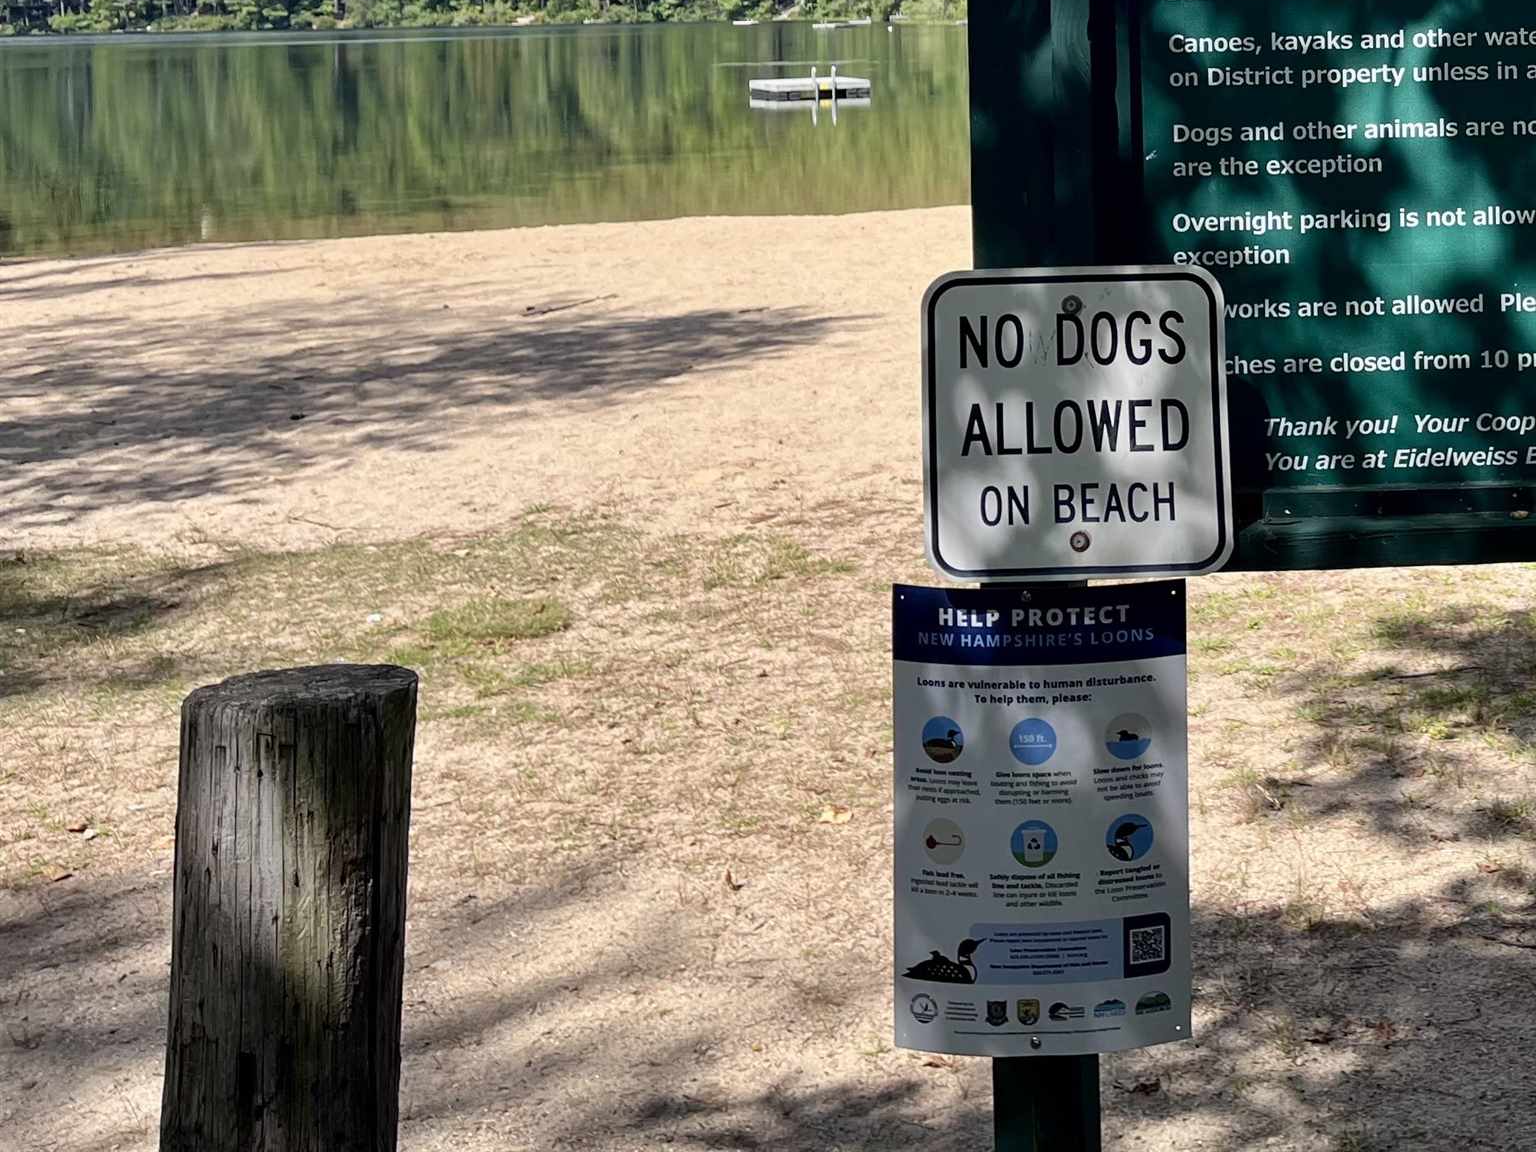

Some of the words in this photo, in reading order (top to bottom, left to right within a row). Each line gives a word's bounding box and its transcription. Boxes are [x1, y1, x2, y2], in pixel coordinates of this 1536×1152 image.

[1172, 123, 1233, 147] Dogs
[1239, 120, 1284, 141] and
[1292, 119, 1358, 140] other
[1363, 116, 1458, 139] animals
[1464, 120, 1505, 137] are
[1224, 297, 1291, 319] works
[1296, 300, 1337, 318] are
[1344, 295, 1385, 316] not
[1390, 292, 1484, 316] allowed
[959, 313, 1025, 369] NO
[1056, 310, 1187, 367] DOGS
[1225, 354, 1276, 375] ches
[1282, 356, 1322, 373] are
[1329, 350, 1405, 372] closed
[1412, 349, 1470, 370] from
[1480, 348, 1509, 369] 10
[960, 398, 1190, 457] ALLOWED
[1263, 415, 1338, 437] Thank
[1345, 414, 1398, 439] you!
[1413, 413, 1470, 433] Your
[1264, 451, 1309, 471] You
[1314, 453, 1355, 470] are
[1361, 448, 1388, 469] at
[1392, 445, 1518, 468] Eidelweiss
[980, 484, 1030, 527] ON
[1053, 481, 1177, 524] BEACH
[938, 606, 1000, 628] HELP
[1011, 604, 1131, 627] PROTECT
[917, 631, 954, 647] NEW
[960, 631, 1083, 648] HAMPSHIRE'S
[1090, 627, 1155, 646] LOONS
[916, 676, 946, 689] Loons
[948, 679, 966, 689] are
[967, 678, 1026, 691] vulnerable
[1029, 679, 1041, 690] to
[1043, 677, 1083, 689] human
[1085, 673, 1157, 687] disturbance.
[974, 693, 987, 705] To
[990, 693, 1014, 706] help
[1017, 693, 1050, 706] them,
[1052, 692, 1093, 706] please:
[1018, 733, 1034, 744] 150
